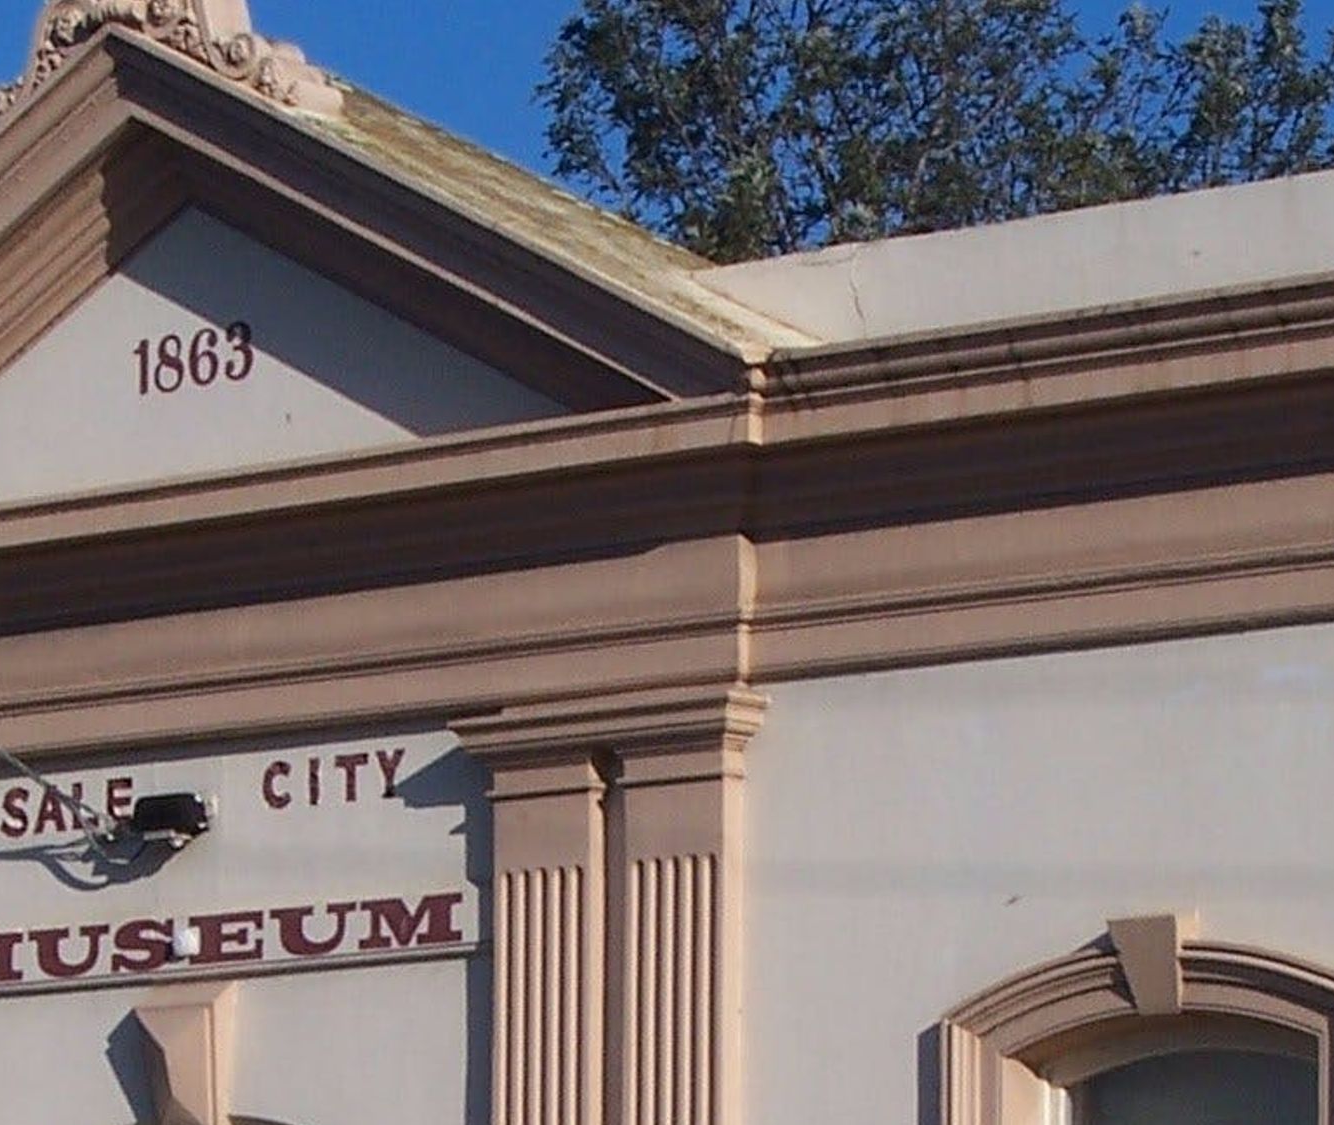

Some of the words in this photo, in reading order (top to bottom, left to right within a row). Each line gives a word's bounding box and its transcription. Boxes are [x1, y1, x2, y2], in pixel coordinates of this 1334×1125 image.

[134, 321, 254, 395] 1863
[0, 777, 133, 837] SALE
[262, 748, 406, 809] CITY
